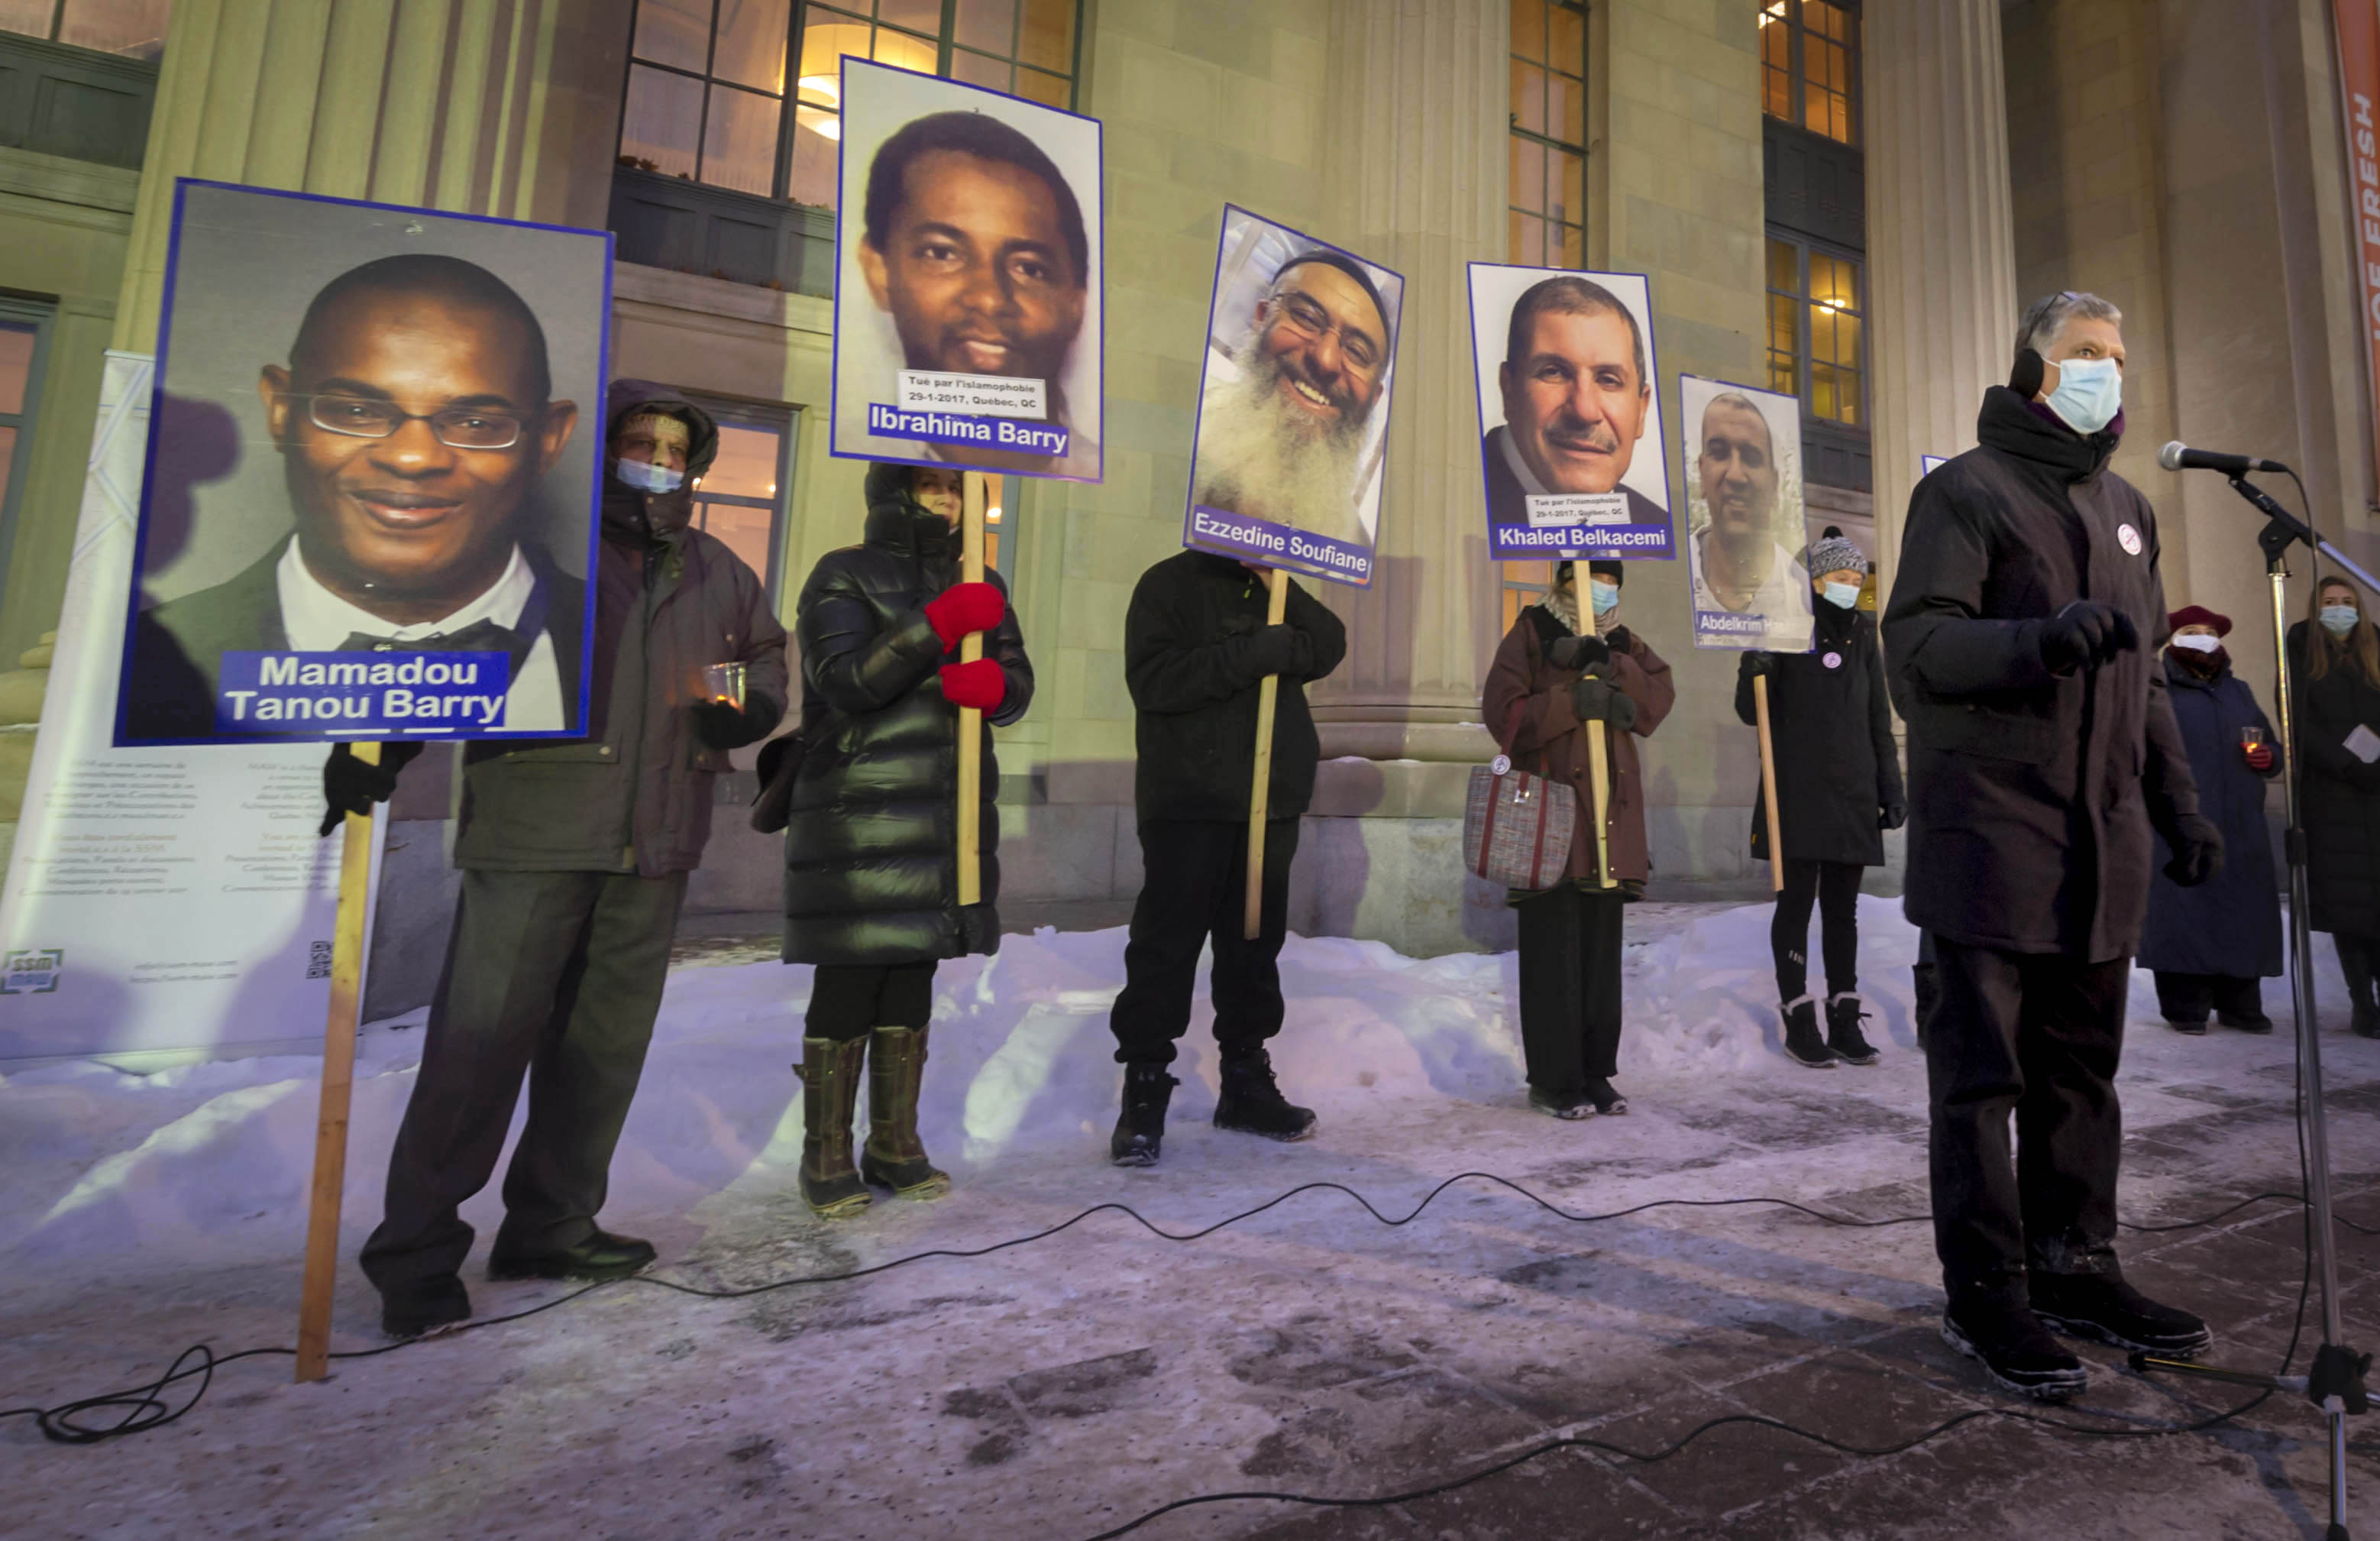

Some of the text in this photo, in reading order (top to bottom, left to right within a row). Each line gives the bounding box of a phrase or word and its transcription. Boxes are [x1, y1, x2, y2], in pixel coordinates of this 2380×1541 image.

[908, 376, 1036, 393] Tué par l'islamophobie
[909, 392, 1036, 408] 29-1-2017, Québec, QC
[871, 406, 1067, 454] Ibrahima Barry
[1194, 512, 1367, 572] Ezzedine Soufiane
[1499, 529, 1666, 546] Khaled Belkacemi
[1700, 614, 1762, 632] Abdelkrim
[260, 656, 477, 686] Mamadou
[225, 688, 504, 724] Tanou Barry
